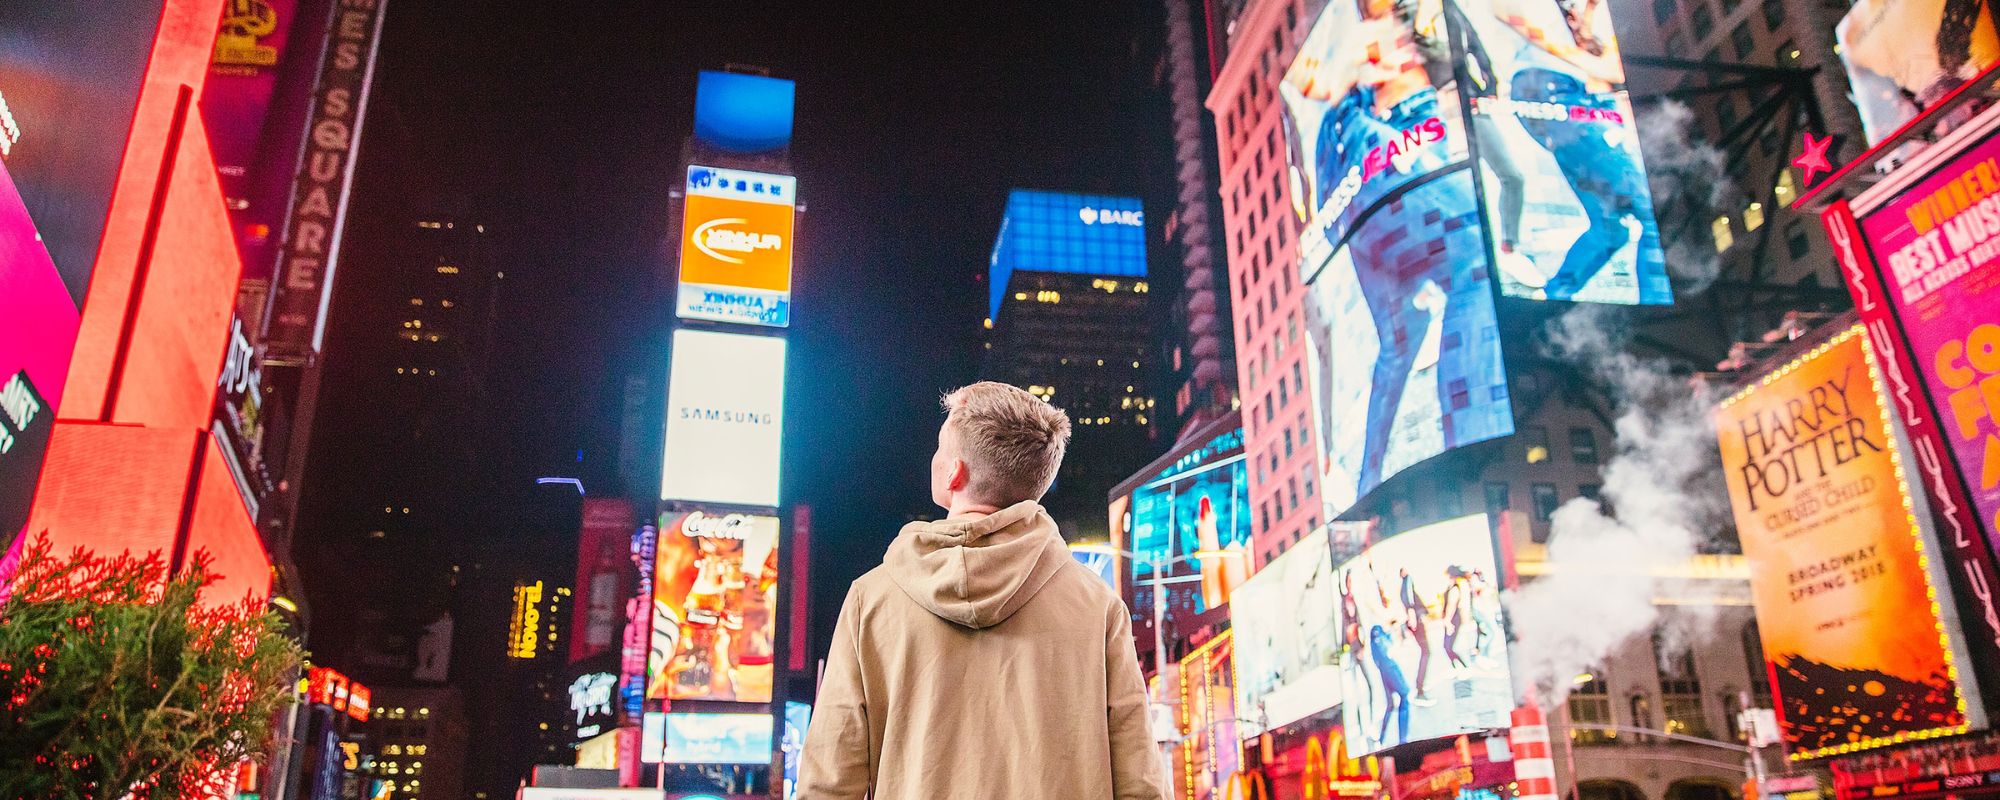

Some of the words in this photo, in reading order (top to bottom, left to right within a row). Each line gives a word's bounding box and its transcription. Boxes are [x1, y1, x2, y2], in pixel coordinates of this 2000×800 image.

[1569, 105, 1624, 125] JEANS
[1362, 117, 1446, 184] JEANS
[286, 87, 352, 289] SQUARE
[1888, 228, 1948, 290] BEST
[681, 406, 772, 425] SAMSUNG
[1739, 365, 1852, 463] HARRY
[1742, 416, 1883, 513] POTTER
[1825, 474, 1876, 508] CHILD
[1788, 544, 1876, 586] BROADWAY
[1789, 573, 1846, 605] SPRING
[519, 579, 543, 658] NOVOTEL
[1944, 773, 1984, 789] SONY
